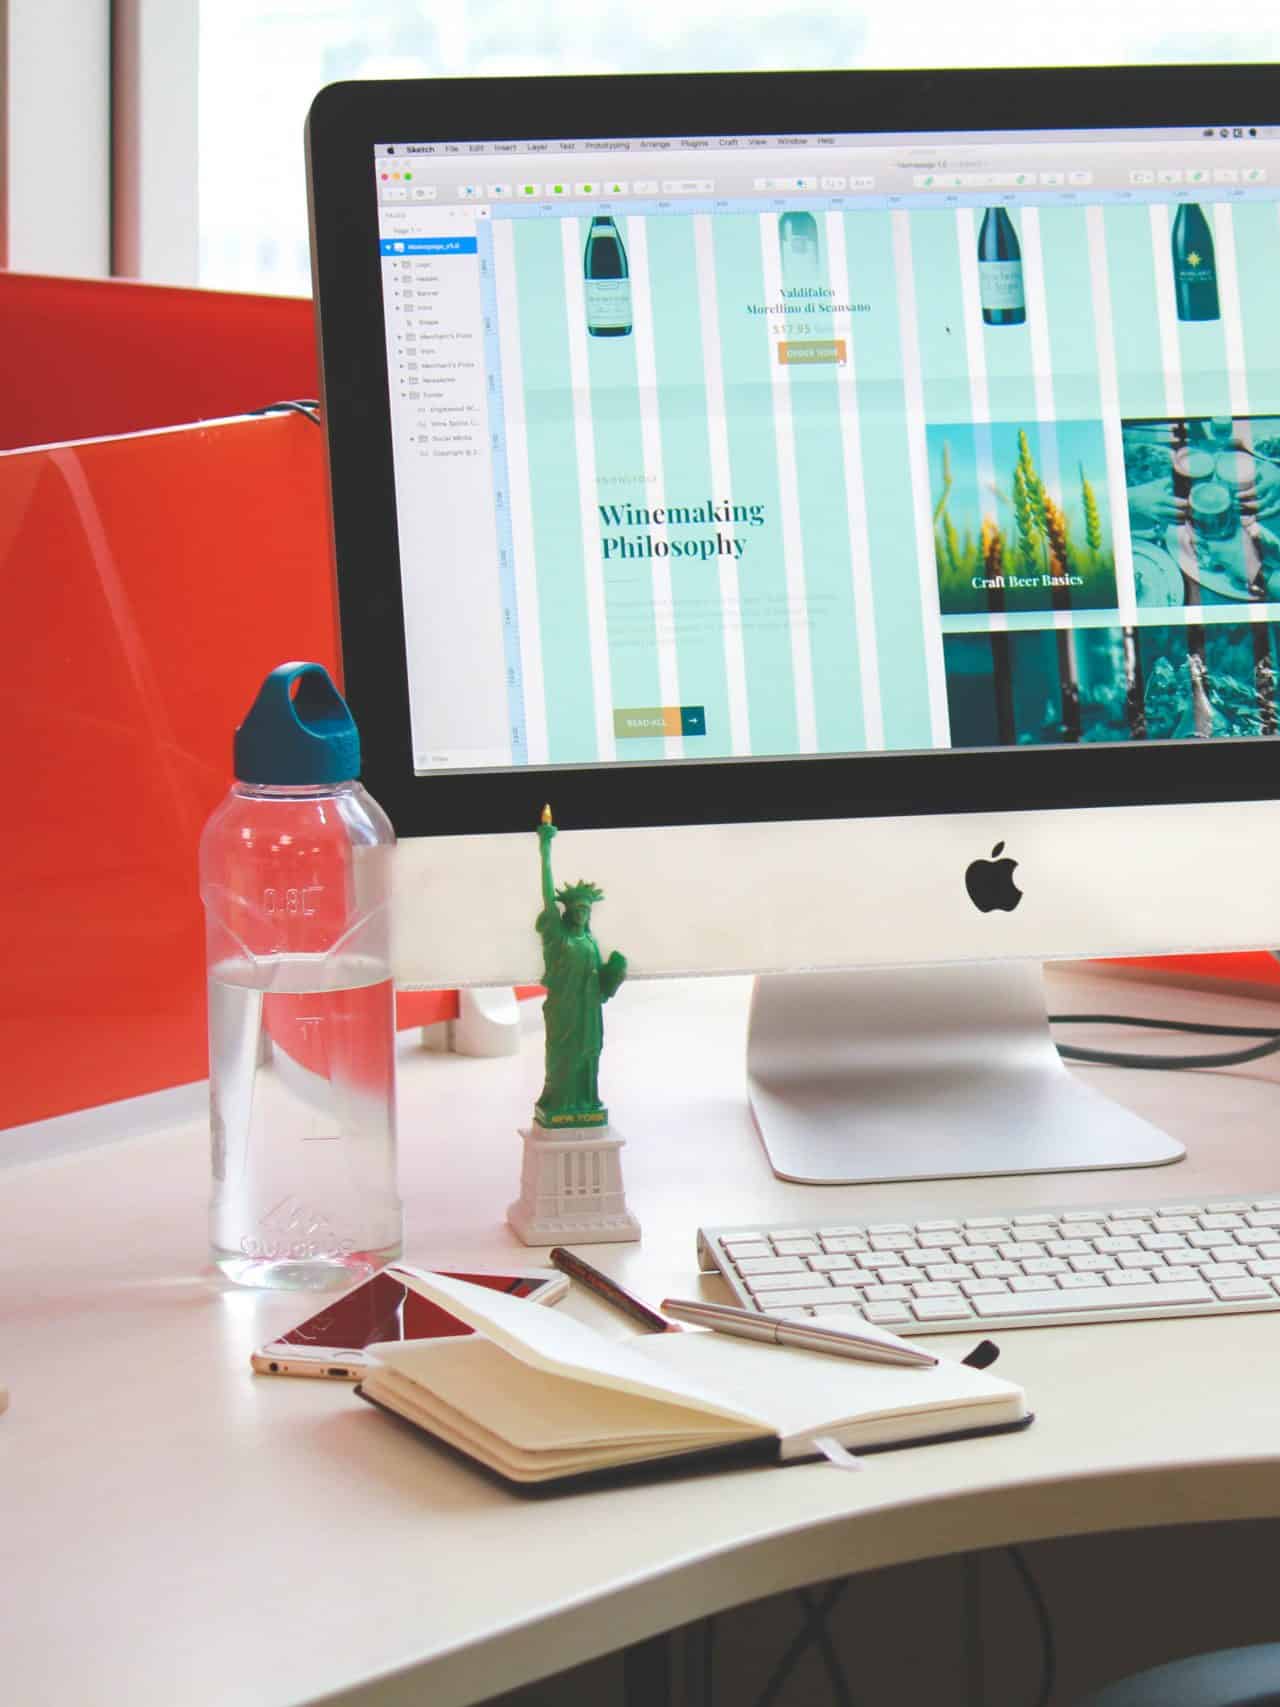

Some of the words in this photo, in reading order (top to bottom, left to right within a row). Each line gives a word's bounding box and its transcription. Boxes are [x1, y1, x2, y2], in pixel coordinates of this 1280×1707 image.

[406, 145, 435, 154] Sketch
[494, 143, 517, 152] Insert
[528, 142, 548, 153] Layer
[585, 140, 630, 151] Prototyping
[640, 140, 671, 149] Arrange
[681, 139, 709, 149] Plugins
[719, 137, 739, 147] Craft
[779, 286, 836, 298] Valdifalco
[746, 302, 802, 315] Morellino
[804, 302, 815, 313] di
[818, 302, 871, 313] Scansano
[598, 499, 765, 526] Winemaking
[602, 532, 747, 560] Philosophy
[971, 576, 1006, 589] Craft
[1008, 575, 1039, 588] Beer
[1041, 573, 1084, 587] Basics
